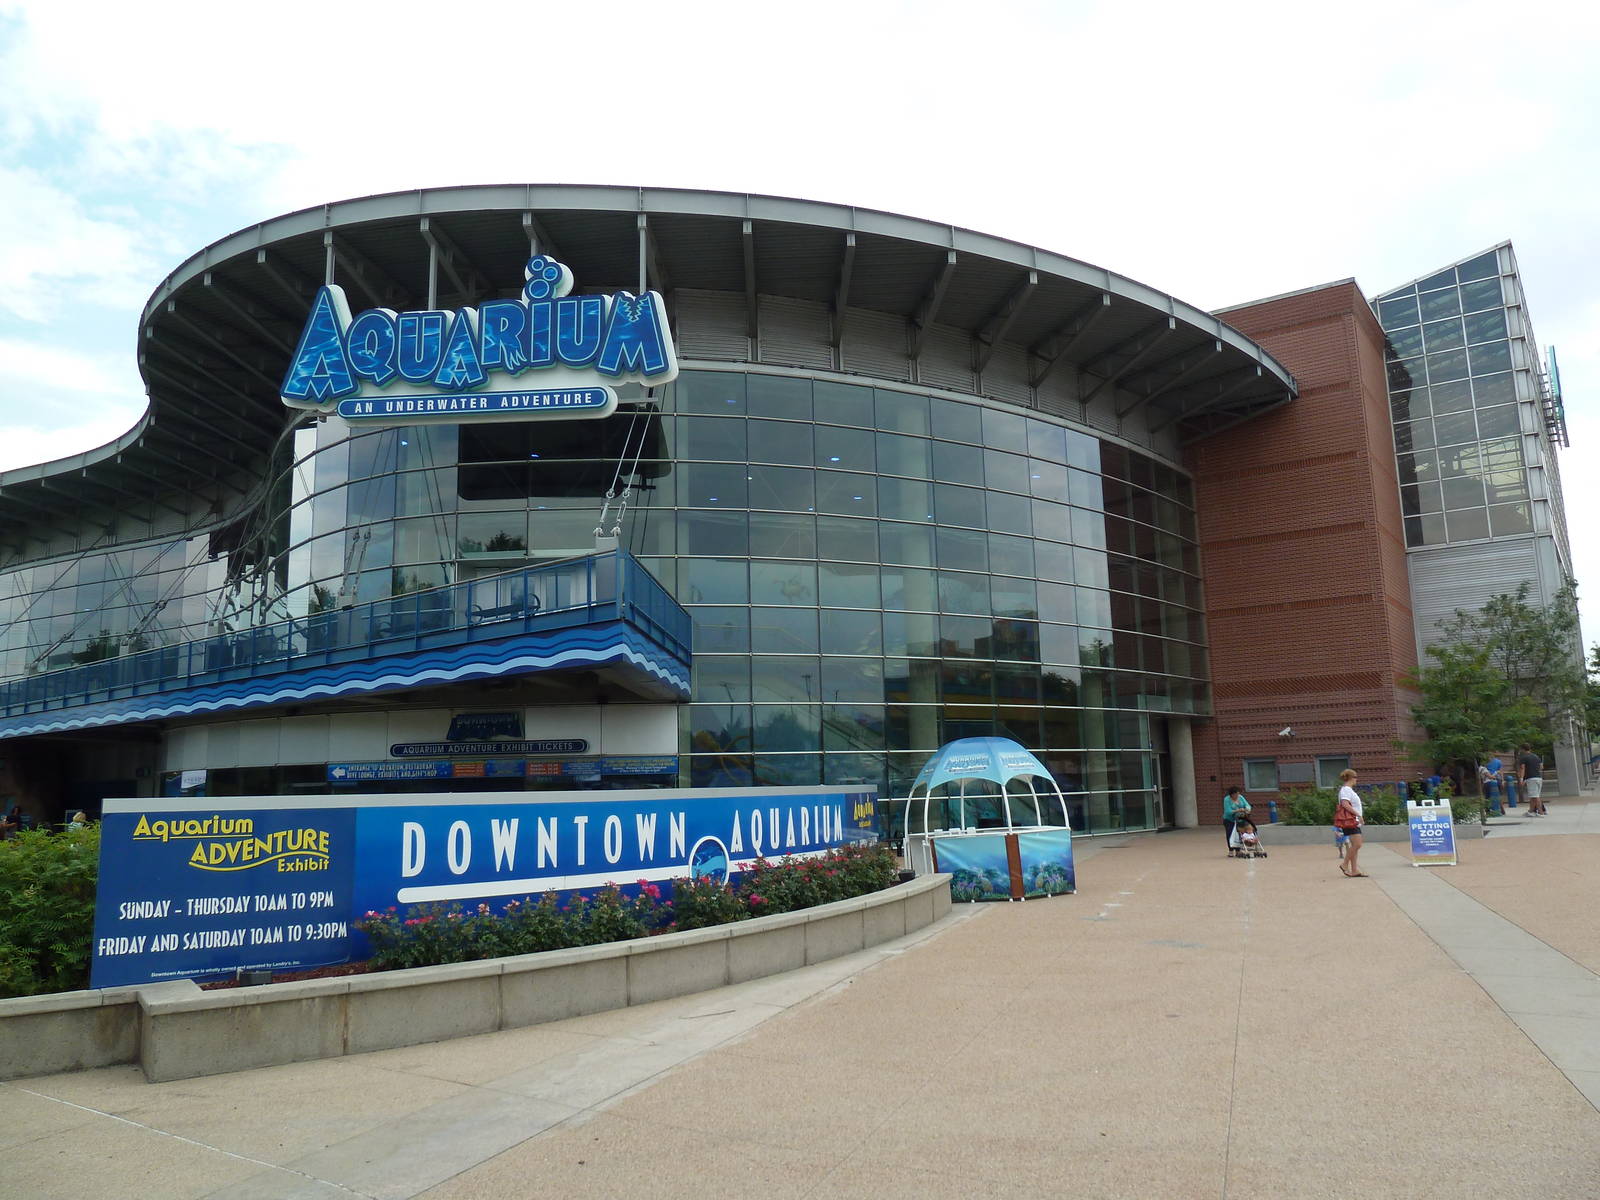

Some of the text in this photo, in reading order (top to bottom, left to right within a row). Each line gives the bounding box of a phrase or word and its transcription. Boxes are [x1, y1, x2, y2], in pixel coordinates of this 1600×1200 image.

[280, 256, 670, 402] AQUARIUM
[355, 393, 593, 414] AN UNDERWATER ADVENTURE
[402, 742, 572, 754] AQUARIUM ADVENTURE EXHIBIT TICKETS
[133, 814, 253, 842] Aquarium
[402, 804, 843, 878] DOWNTOWN AQUARIUM
[1420, 829, 1443, 837] ZOO
[190, 828, 330, 866] ADVENTURE
[278, 857, 330, 873] Exhibit
[119, 900, 171, 920] SUNDAY
[187, 895, 251, 916] THURSDAY
[255, 893, 287, 912] 10AM
[292, 892, 305, 909] TO
[310, 890, 334, 908] 9PM
[98, 921, 348, 957] FRIDAY AND SATURDAY 10AM TO 9:30PM
